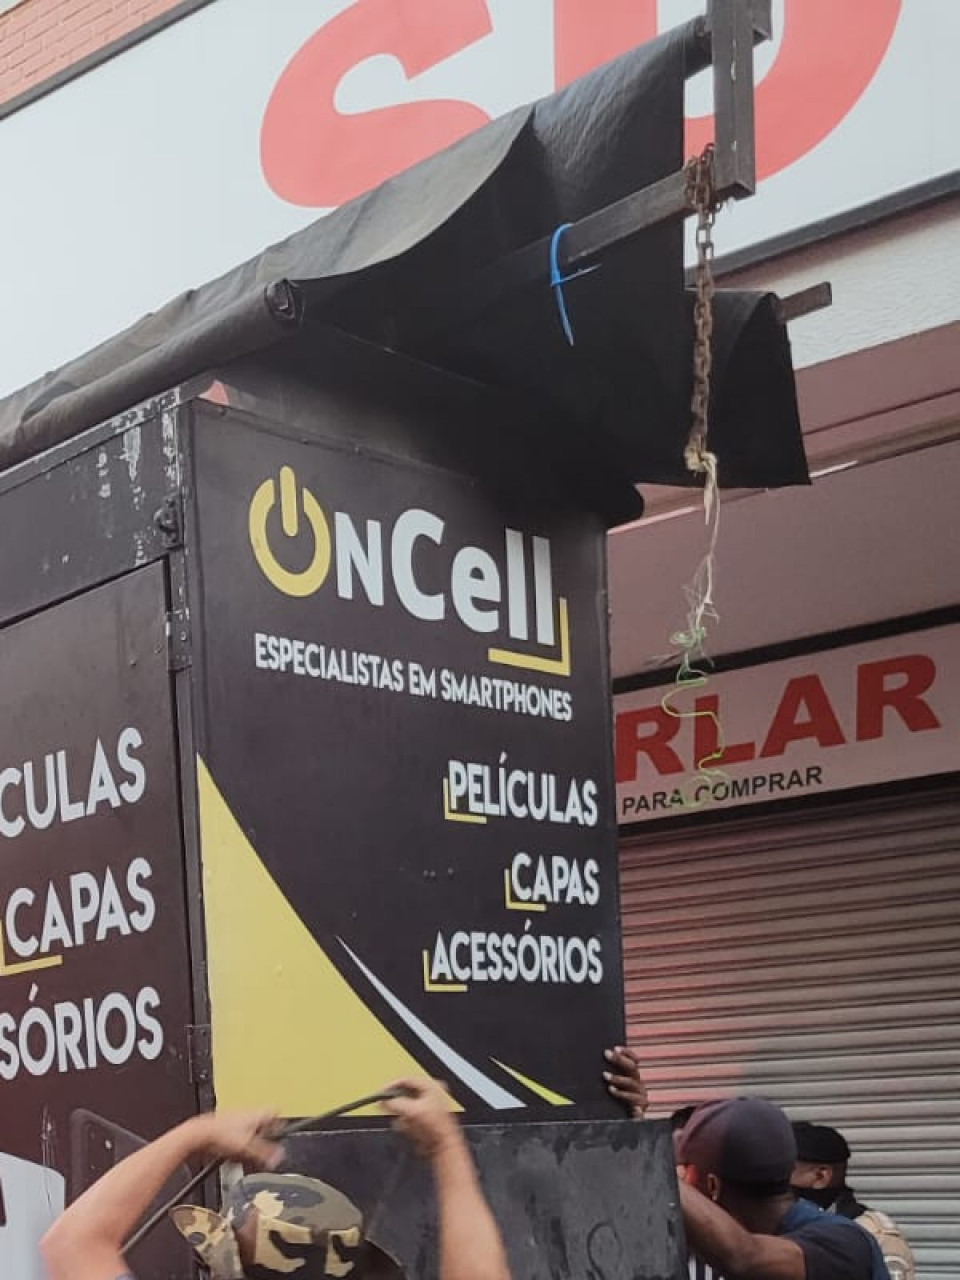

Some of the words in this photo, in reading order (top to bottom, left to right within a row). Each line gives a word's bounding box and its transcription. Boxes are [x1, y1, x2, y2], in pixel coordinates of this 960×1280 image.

[254, 632, 404, 692] ESPECIALISTAS
[409, 664, 437, 698] EM
[441, 675, 573, 721] SMARTPHONES
[448, 752, 598, 826] PELÍCULAS
[622, 788, 684, 816] PARA
[695, 766, 823, 803] COMPRAR
[5, 857, 157, 958] CAPAS
[511, 853, 600, 905] CAPAS
[431, 920, 603, 984] ACESSÓRIOS
